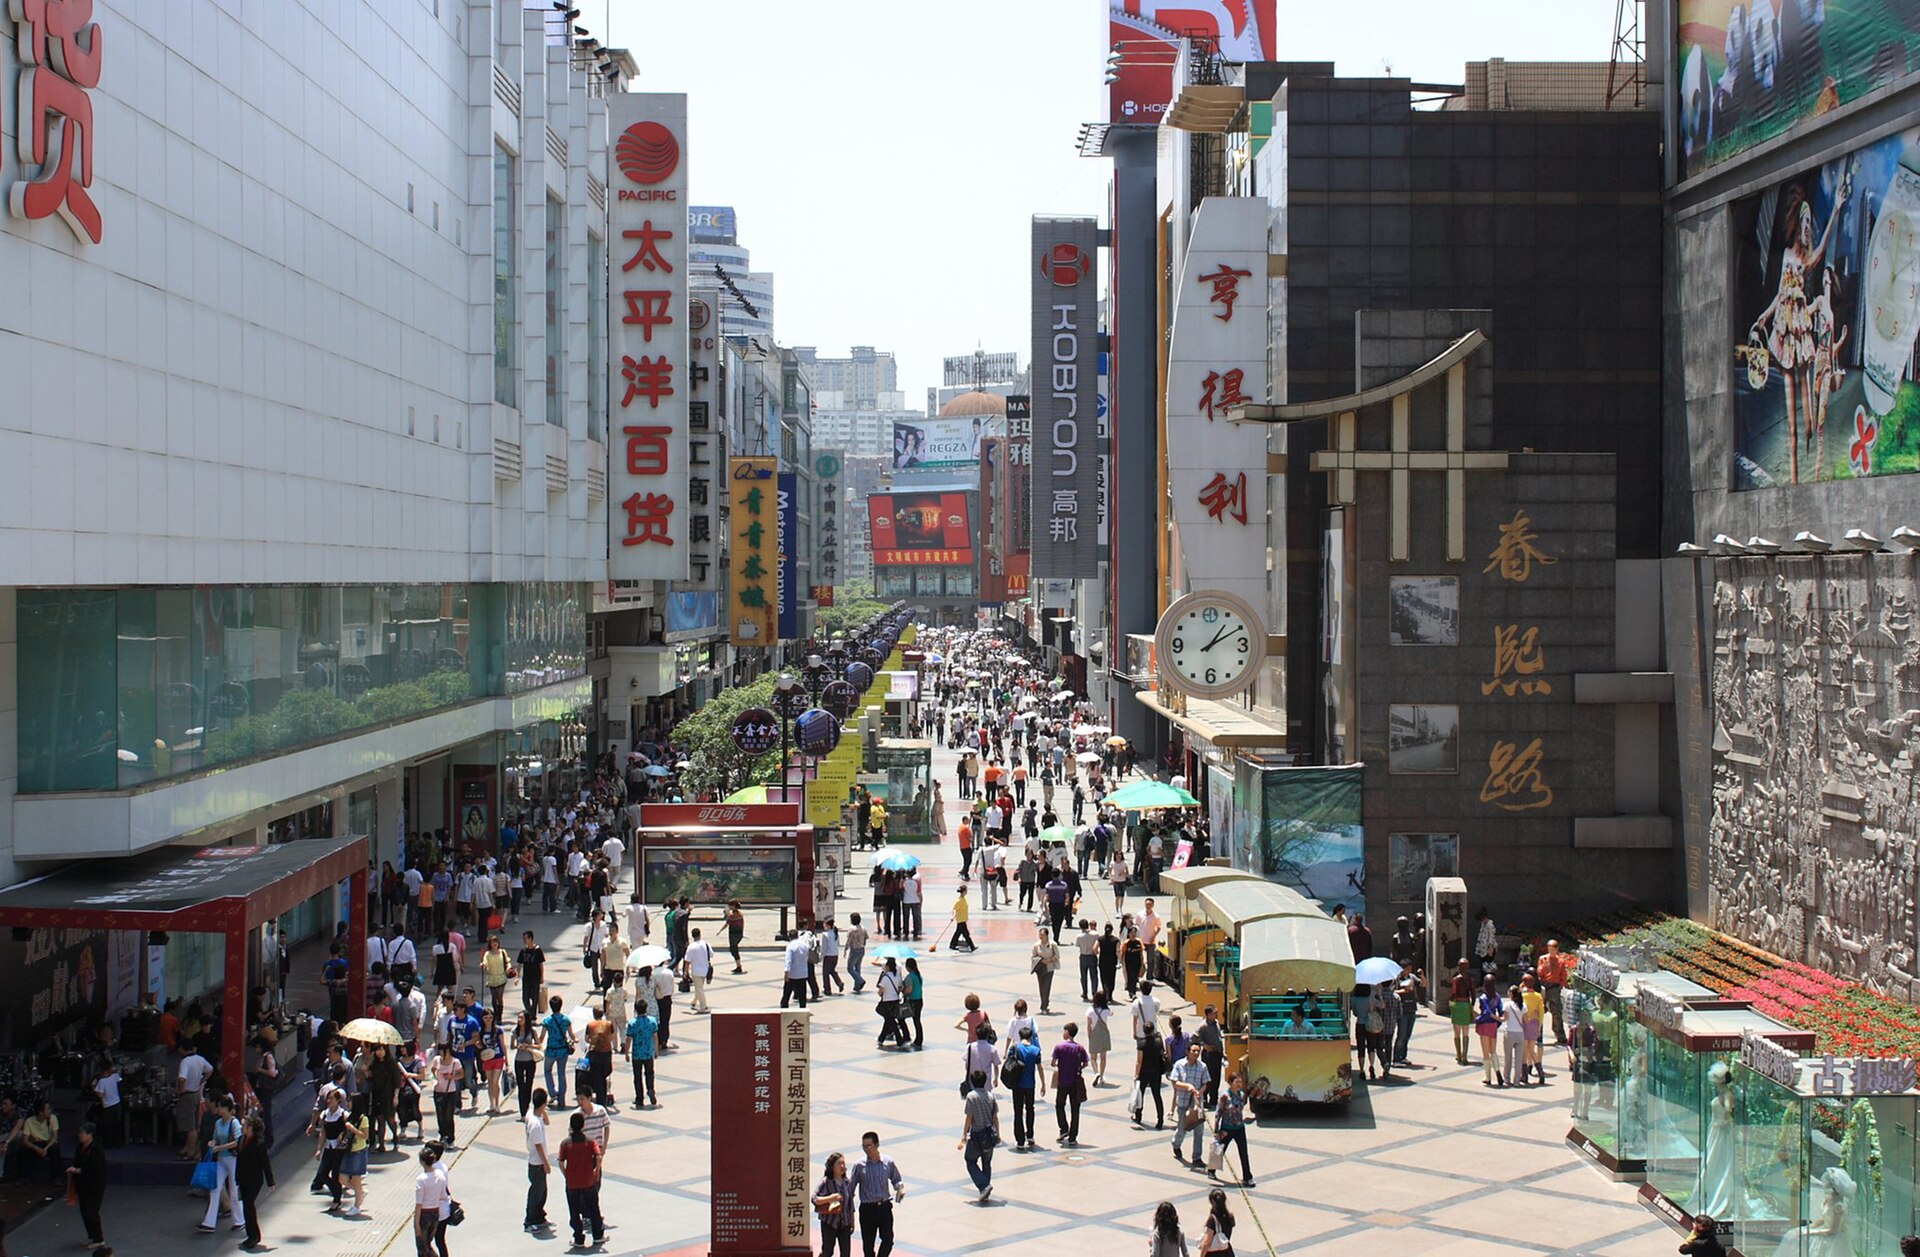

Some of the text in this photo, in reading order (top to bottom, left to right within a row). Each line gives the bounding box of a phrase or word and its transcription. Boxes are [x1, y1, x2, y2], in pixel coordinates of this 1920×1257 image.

[618, 189, 677, 202] PACIFIC
[621, 219, 675, 547] 太平洋百货
[929, 443, 968, 453] REGZA
[1049, 488, 1078, 542] 高邦
[1172, 637, 1249, 654] 9 3
[1479, 509, 1558, 811] 春熙路
[1205, 668, 1217, 684] 6
[697, 806, 750, 822] 可口可乐
[753, 1022, 771, 1115] 春熙路示范街
[1808, 1053, 1917, 1094] 古摄影
